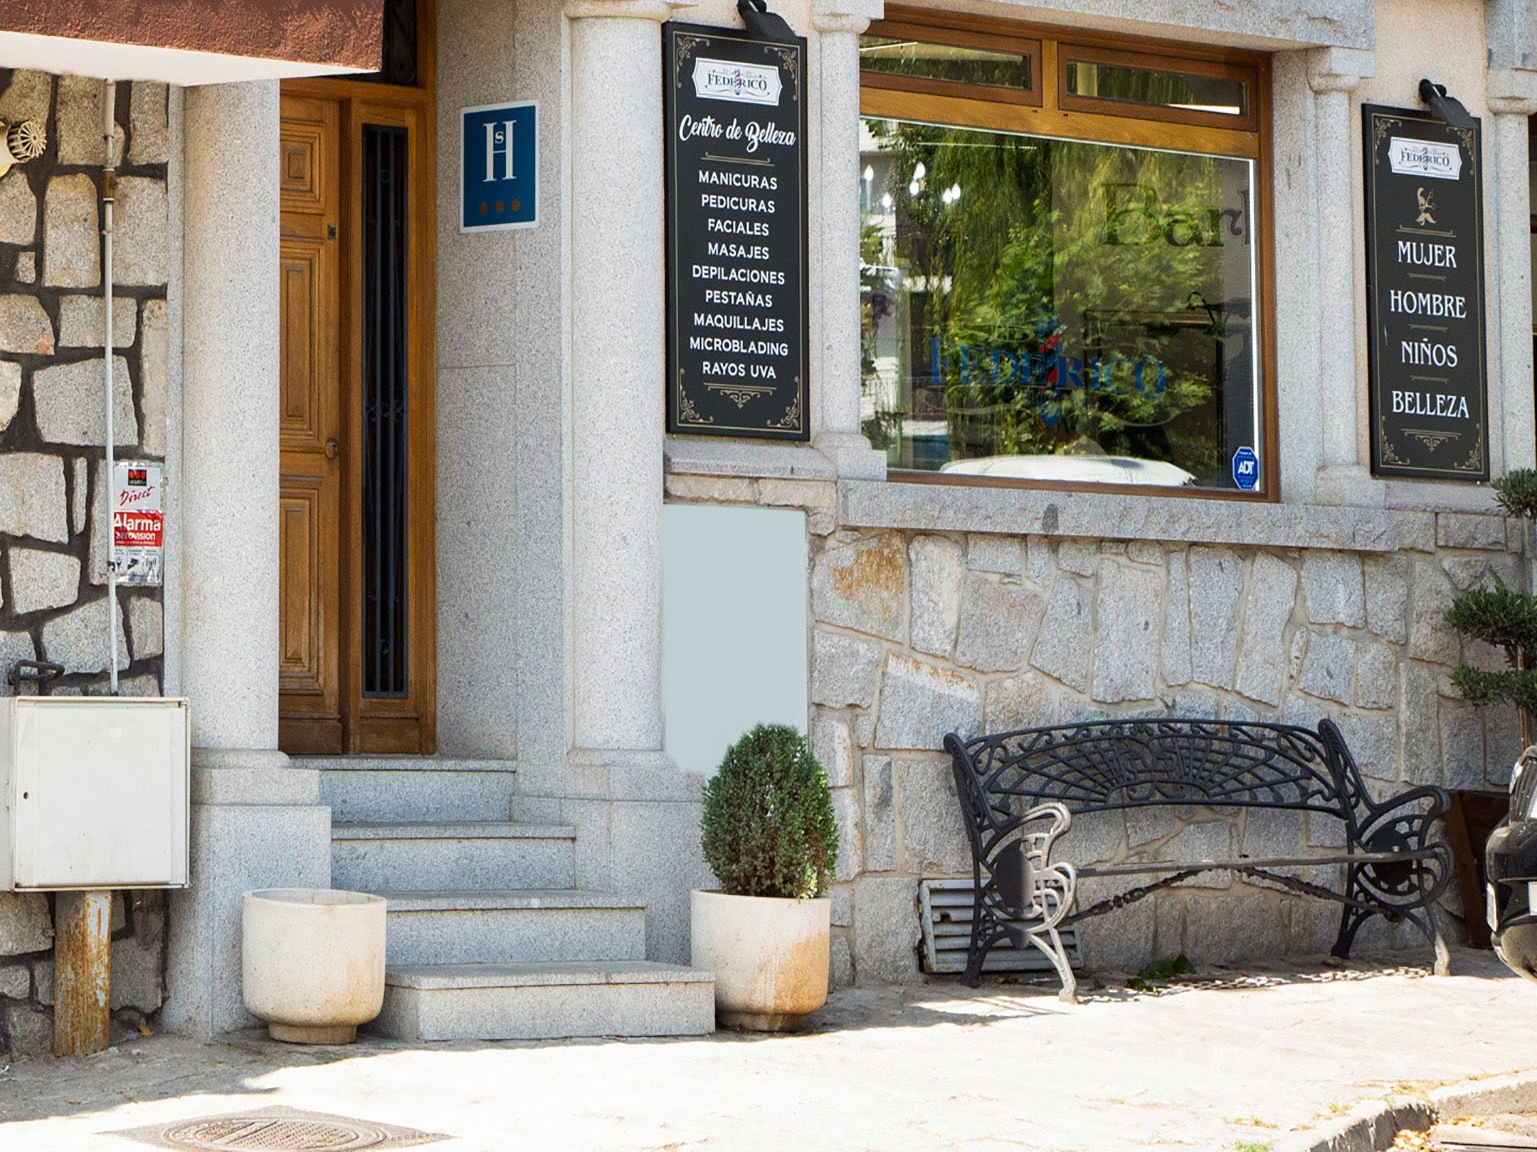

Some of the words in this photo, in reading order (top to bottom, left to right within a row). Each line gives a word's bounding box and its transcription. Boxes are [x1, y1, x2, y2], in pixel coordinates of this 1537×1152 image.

[707, 72, 768, 92] FEDERICO
[679, 114, 725, 142] Centro
[725, 118, 743, 139] de
[744, 121, 796, 153] Belleza
[483, 119, 517, 183] H
[698, 169, 778, 191] MANICURAS
[701, 194, 776, 214] PEDICURAS
[707, 218, 769, 237] FACIALES
[707, 242, 770, 260] MASAJES
[1397, 240, 1457, 269] MUJER
[692, 264, 785, 285] DEPILACIONES
[705, 289, 773, 308] PESTAÑAS
[1389, 289, 1467, 319] HOMBRE
[693, 312, 784, 333] MAQUILLAJES
[689, 336, 789, 357] MICROBLADING
[1400, 337, 1458, 368] NIÑOS
[702, 361, 746, 378] RAYOS
[750, 364, 777, 380] UVA
[930, 336, 1167, 400] FEDERICO
[1391, 390, 1470, 419] BELLEZA
[1237, 460, 1255, 475] ADT
[119, 485, 155, 506] Direct
[113, 513, 161, 531] Alarma
